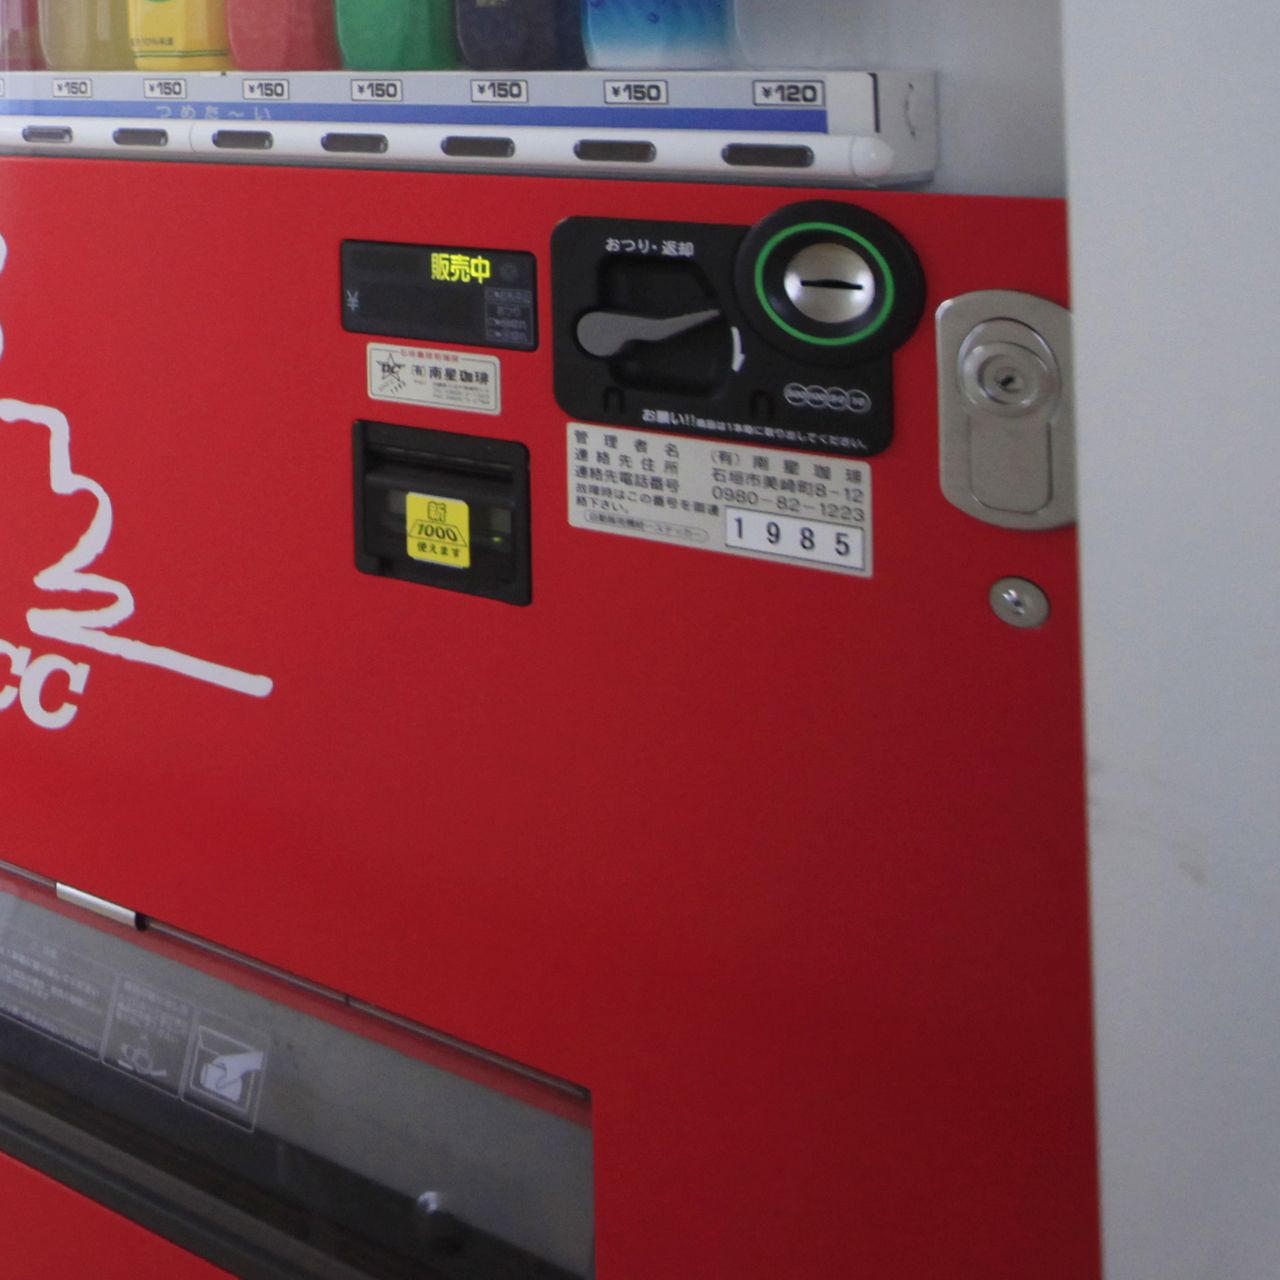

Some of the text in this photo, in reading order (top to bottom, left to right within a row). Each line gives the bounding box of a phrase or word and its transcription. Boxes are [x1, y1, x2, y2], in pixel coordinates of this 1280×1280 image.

[56, 82, 88, 95] ¥150
[148, 82, 183, 96] ¥150
[247, 83, 285, 97] ¥150
[357, 82, 398, 99] ¥150
[477, 81, 523, 100] ¥150
[610, 82, 662, 103] ¥150
[760, 84, 819, 104] ¥120
[605, 237, 696, 257] おつり・返却
[430, 251, 492, 285] 販売中
[346, 289, 360, 312] ¥
[573, 429, 681, 459] 管理者名
[573, 447, 680, 476] 連絡先住所
[574, 465, 866, 523] 連絡先電話番号 0980-82-1223
[416, 523, 458, 543] 1000
[734, 517, 852, 557] 1985
[417, 541, 461, 559] 使えます
